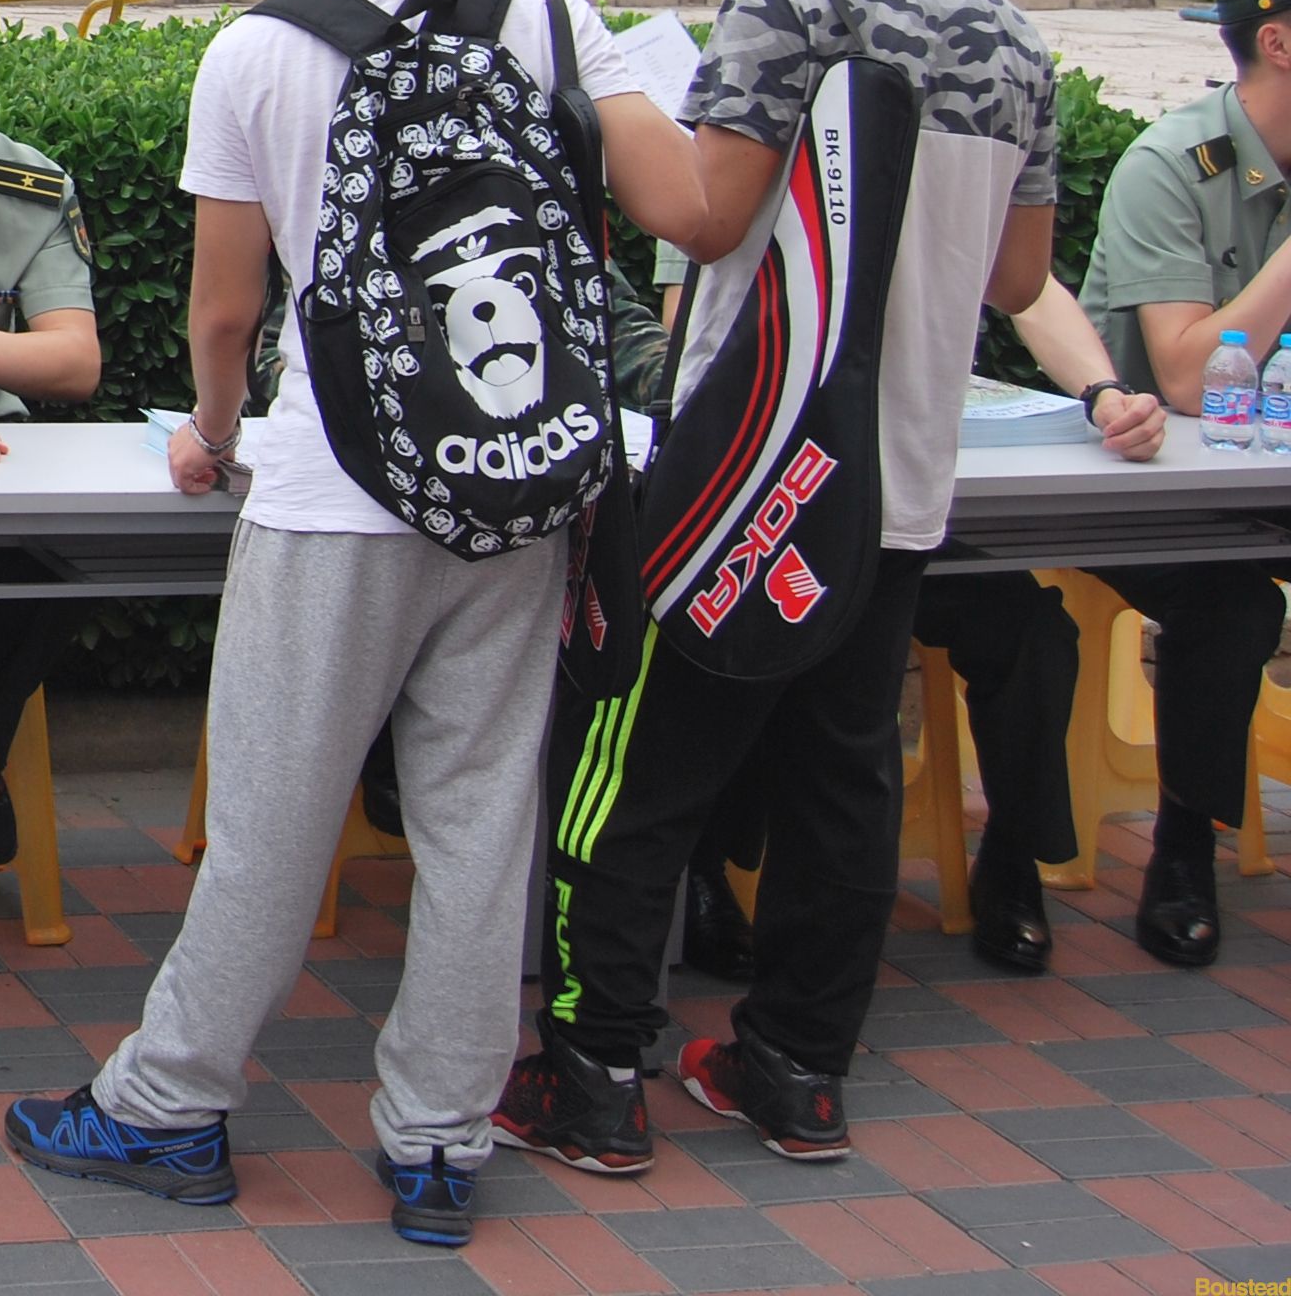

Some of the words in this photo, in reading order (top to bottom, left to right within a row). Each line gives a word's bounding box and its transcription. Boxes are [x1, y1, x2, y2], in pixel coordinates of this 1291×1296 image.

[824, 128, 847, 226] BK-9110
[435, 403, 600, 481] adidas
[686, 437, 839, 638] BOKAI
